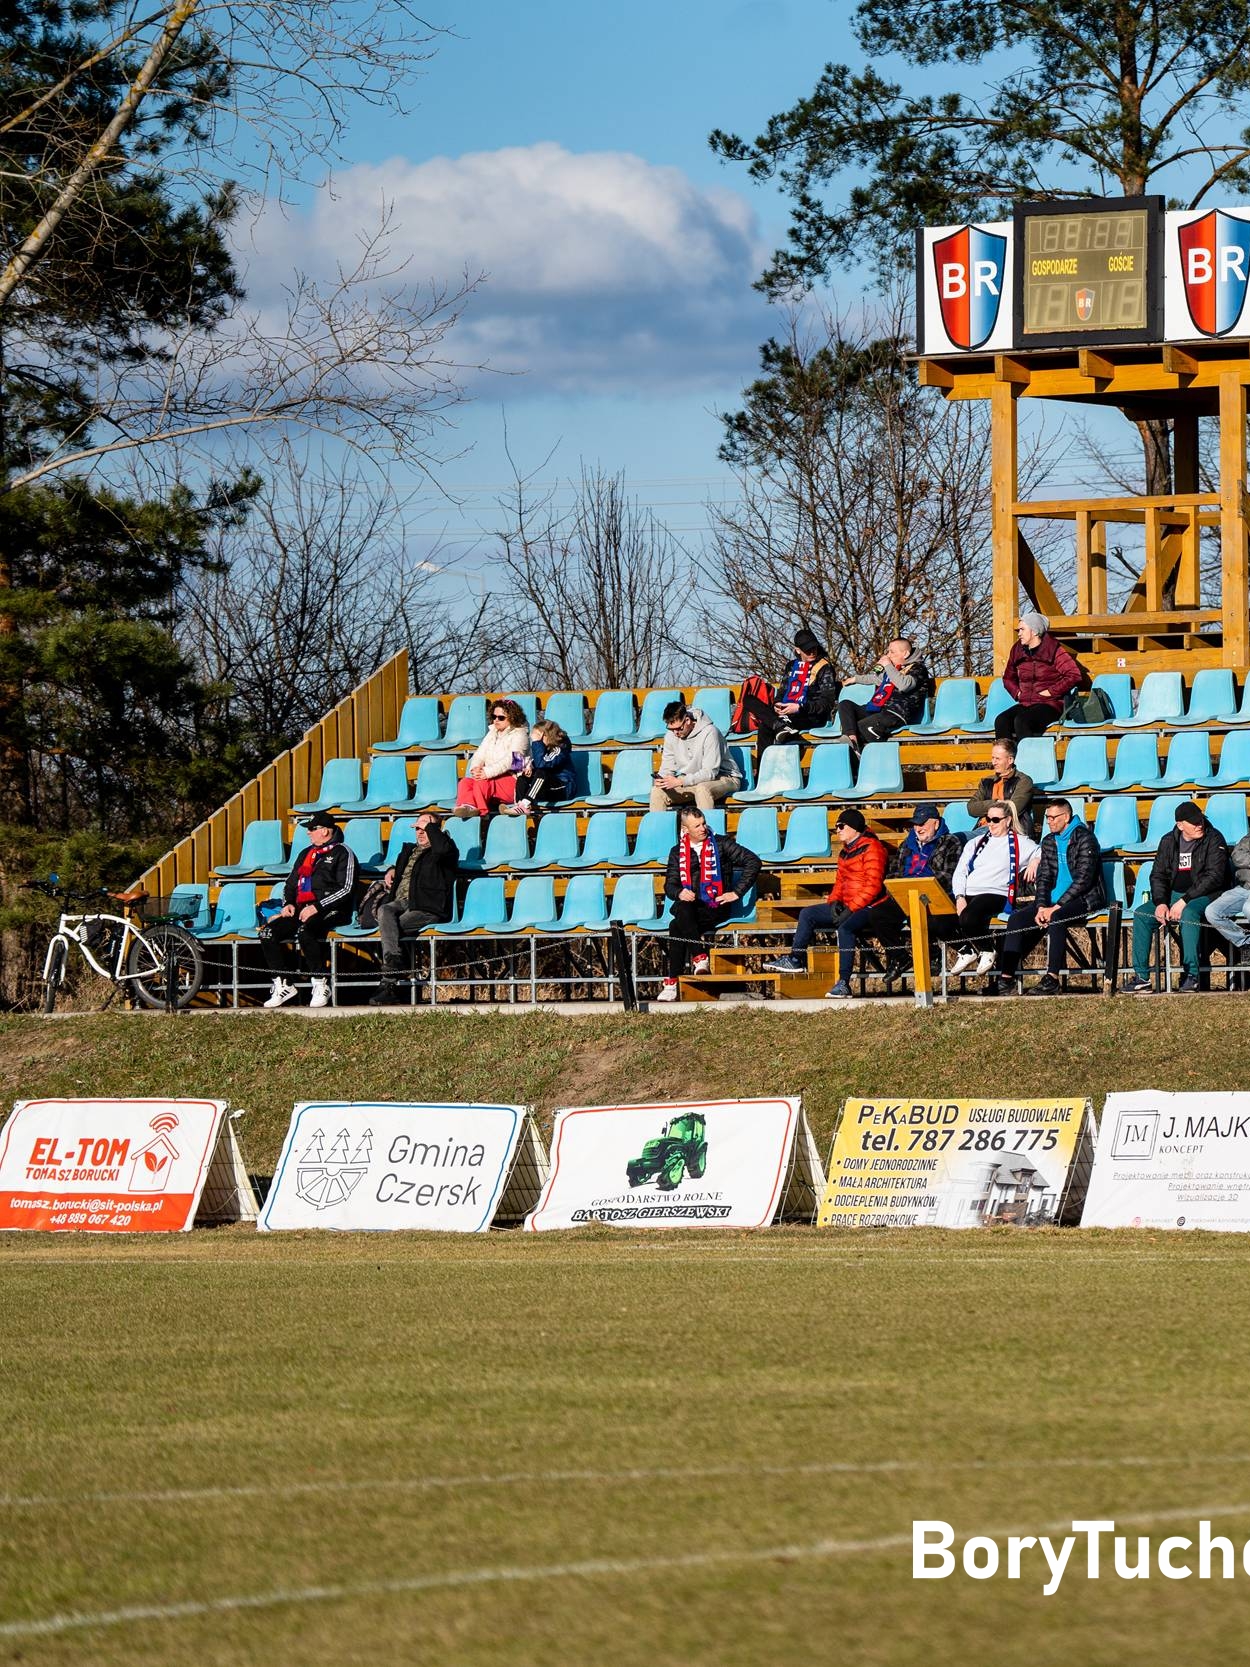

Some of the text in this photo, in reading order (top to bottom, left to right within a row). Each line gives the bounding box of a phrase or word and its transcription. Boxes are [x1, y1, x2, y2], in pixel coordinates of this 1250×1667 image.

[1032, 258, 1078, 276] GOSPODARZE
[1108, 251, 1134, 273] GOŚCIE
[1187, 244, 1247, 285] BR
[942, 260, 1000, 300] BR
[1078, 298, 1092, 308] BR
[968, 1108, 1006, 1123] USŁUGI
[1008, 1107, 1073, 1123] BUDOWLANE
[861, 1128, 1059, 1151] tel. 787 286 775
[1123, 1124, 1149, 1145] JM
[28, 1138, 131, 1166] EL-TOM
[388, 1135, 485, 1167] Gmina
[1159, 1145, 1205, 1154] KONCEPT
[843, 1158, 939, 1171] DOMY JEDNORODZINNE
[25, 1167, 120, 1182] TOMASZ BORUCKI
[838, 1175, 928, 1189] MAŁA ARCHITEKTURA
[376, 1173, 482, 1207] Czersk
[683, 1191, 724, 1202] ROLNE
[10, 1198, 164, 1212] tomasz.borucki@sit-polska.pl
[834, 1194, 937, 1208] DOCIEPLENIA BUDYNKÓW
[50, 1213, 132, 1226] +48 889 067 420
[572, 1205, 732, 1221] BARTOSZ GIERSZEWSKI
[830, 1213, 858, 1226] PRACE
